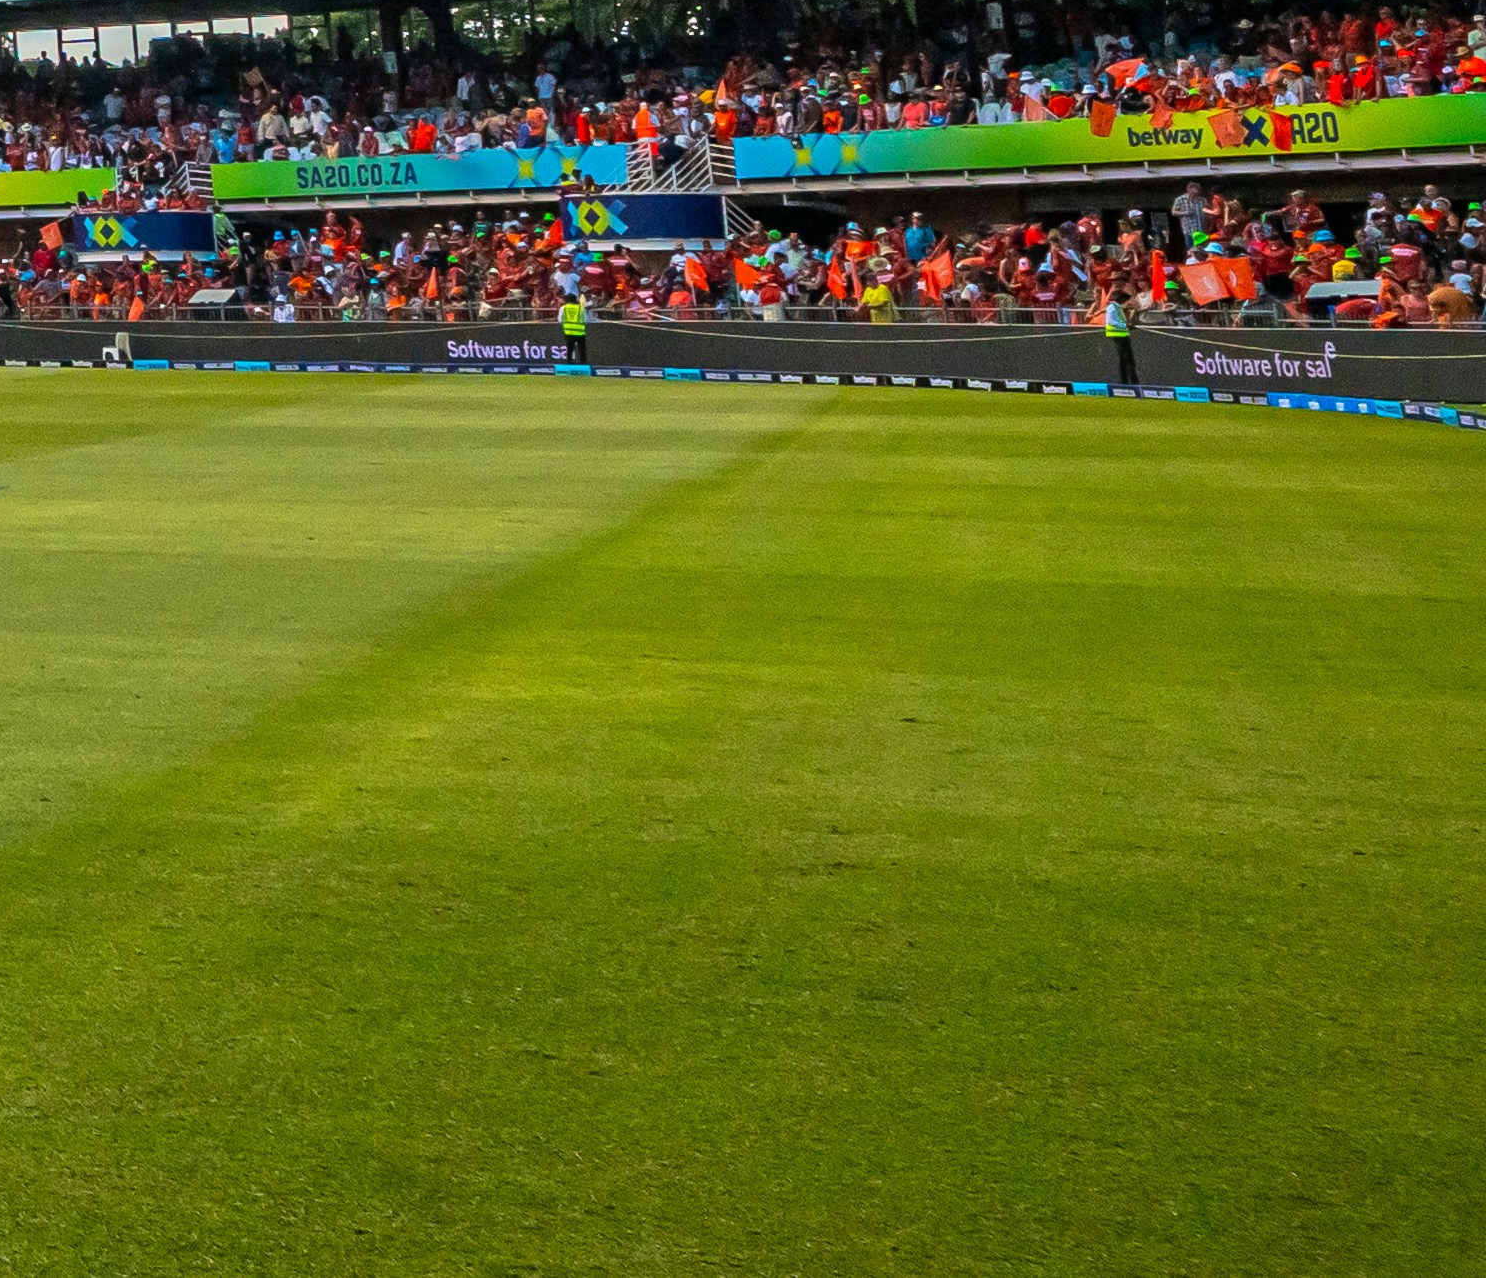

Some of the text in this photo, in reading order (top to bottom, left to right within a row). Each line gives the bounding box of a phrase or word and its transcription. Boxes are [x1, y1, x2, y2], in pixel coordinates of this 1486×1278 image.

[1127, 127, 1203, 149] betway
[296, 162, 418, 189] SA20.CO.ZA
[447, 339, 521, 360] Software
[523, 340, 547, 359] for
[1193, 341, 1336, 378] Software for sale
